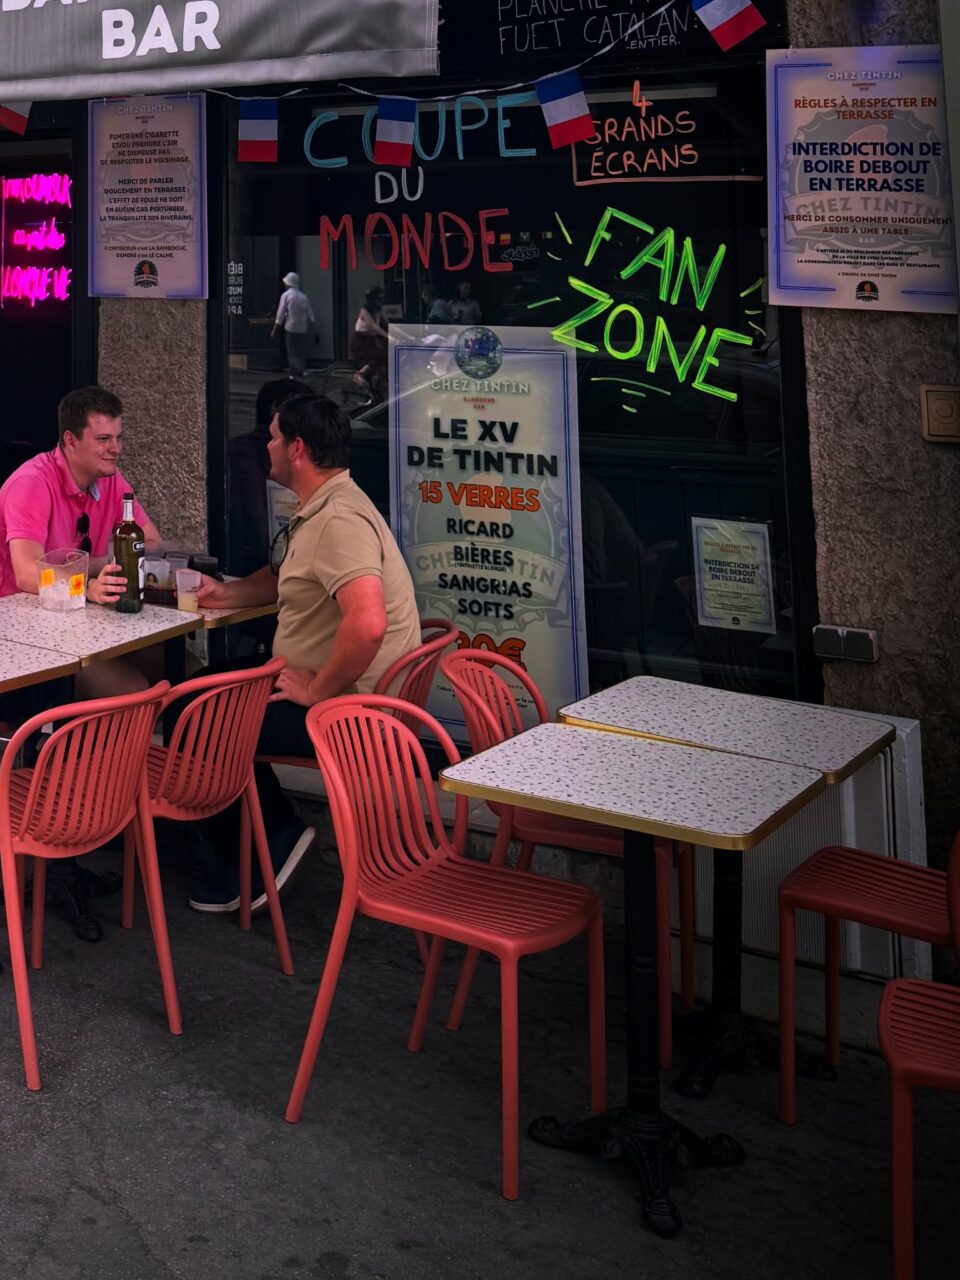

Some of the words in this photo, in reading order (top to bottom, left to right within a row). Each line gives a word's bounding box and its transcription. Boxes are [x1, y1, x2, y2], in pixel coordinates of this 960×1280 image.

[102, 0, 221, 60] BAR
[498, 18, 566, 55] FUET
[827, 71, 857, 81] CHEZ
[861, 70, 903, 80] TINTIN
[632, 79, 654, 117] 4
[794, 96, 837, 109] RÈGLES
[840, 95, 849, 108] À
[851, 97, 918, 108] RESPECTER
[920, 97, 937, 107] EN
[835, 110, 895, 120] TERRASSE
[109, 132, 130, 140] FUMER
[144, 130, 180, 139] CIGARETTE
[132, 140, 161, 148] PRENDRE
[127, 149, 157, 157] DISPENSE
[792, 142, 914, 156] INTERDICTION
[919, 142, 942, 156] DE
[590, 143, 699, 177] ÉCRANS
[803, 160, 854, 174] BOIRE
[860, 160, 930, 174] DEBOUT
[375, 166, 425, 204] DU
[809, 177, 832, 192] EN
[835, 177, 925, 193] TERRASSE
[795, 197, 852, 216] CHEZ
[860, 196, 940, 218] TINTIN
[784, 214, 812, 222] MERCI
[814, 215, 826, 223] DE
[828, 215, 889, 224] CONSOMMER
[822, 226, 850, 234] ASSIS
[851, 224, 859, 234] À
[860, 226, 880, 235] UNE
[319, 207, 514, 273] MONDE
[583, 206, 727, 311] FAN
[551, 276, 753, 402] ZONE
[431, 379, 470, 392] CHEZ
[475, 380, 530, 394] TINTIN
[433, 417, 468, 440] LE
[478, 420, 519, 443] XV
[407, 445, 444, 469] DE
[453, 448, 558, 477] TINTIN
[418, 480, 443, 504] 15
[447, 482, 541, 513] VERRES
[446, 518, 515, 539] RICARD
[453, 542, 514, 567] BIÈRES
[704, 559, 750, 569] INTERDICTION
[708, 566, 729, 574] BOIRE
[729, 569, 757, 577] DEBOUT
[711, 573, 720, 581] EN
[720, 575, 755, 585] TERRASSE
[438, 573, 533, 599] SANGRIAS
[457, 598, 515, 620] SOFTS
